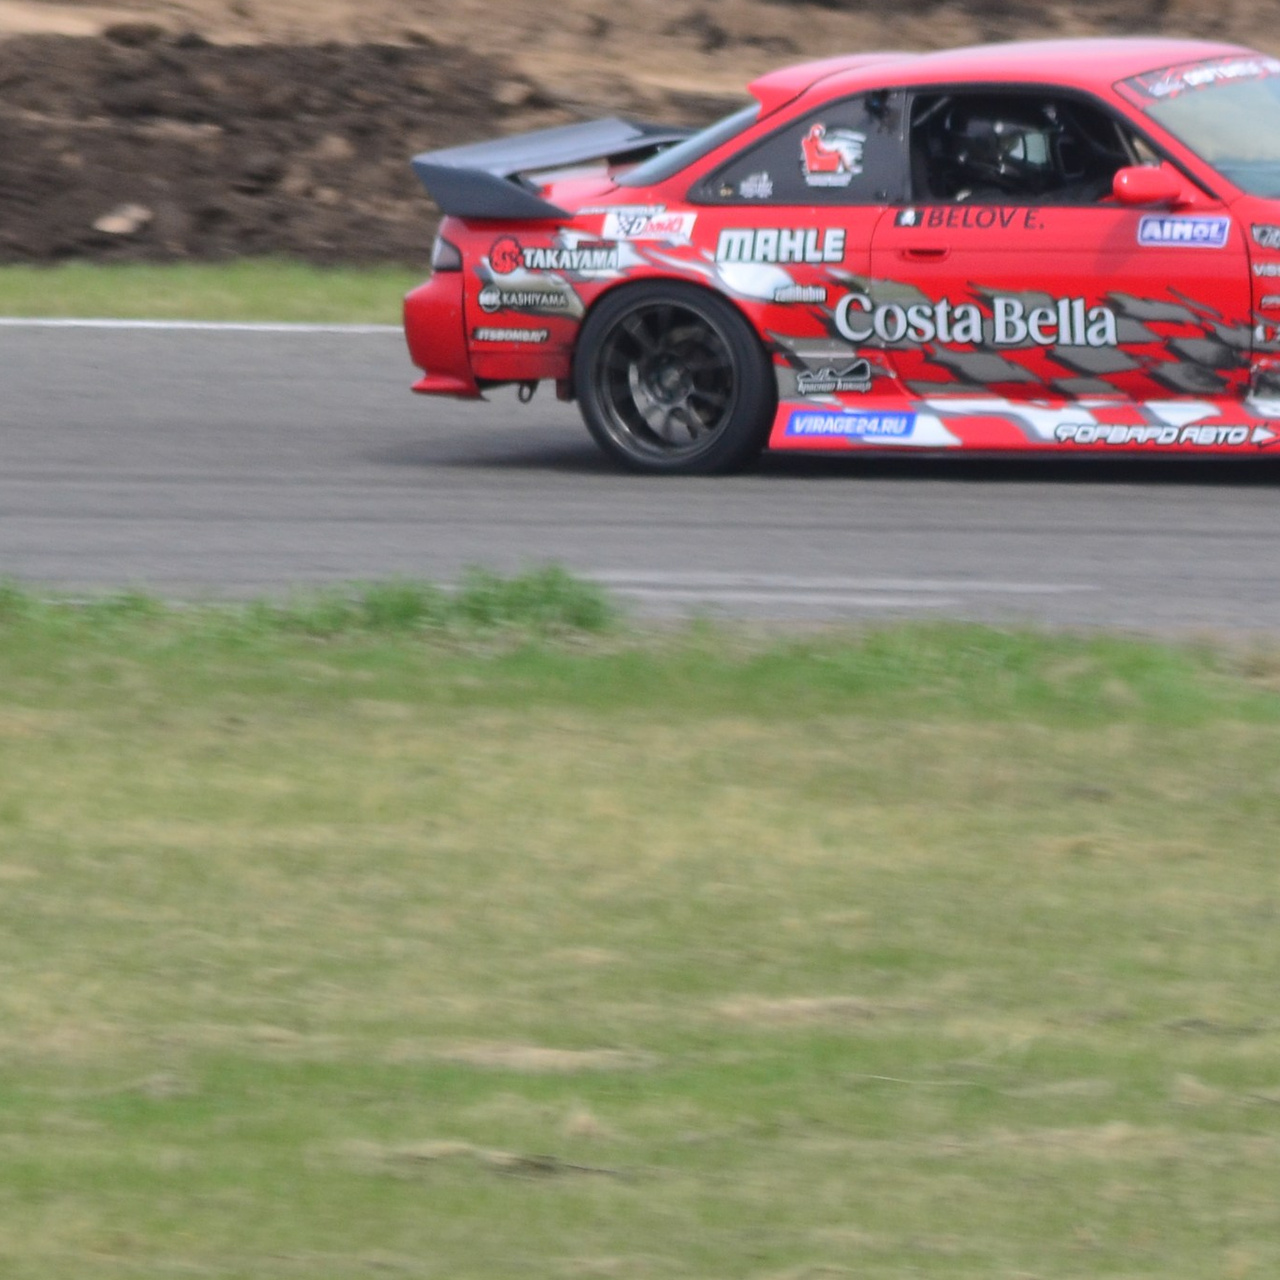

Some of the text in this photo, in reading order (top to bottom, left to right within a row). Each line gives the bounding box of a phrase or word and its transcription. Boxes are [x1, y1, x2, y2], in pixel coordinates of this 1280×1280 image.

[927, 206, 1017, 229] BELOV
[715, 227, 846, 263] MAHLE
[522, 248, 618, 270] TAKAYAMA
[501, 292, 567, 308] KASHIYAMA
[834, 292, 1118, 347] Costa Bella
[794, 415, 908, 434] VIRAGE24.RU
